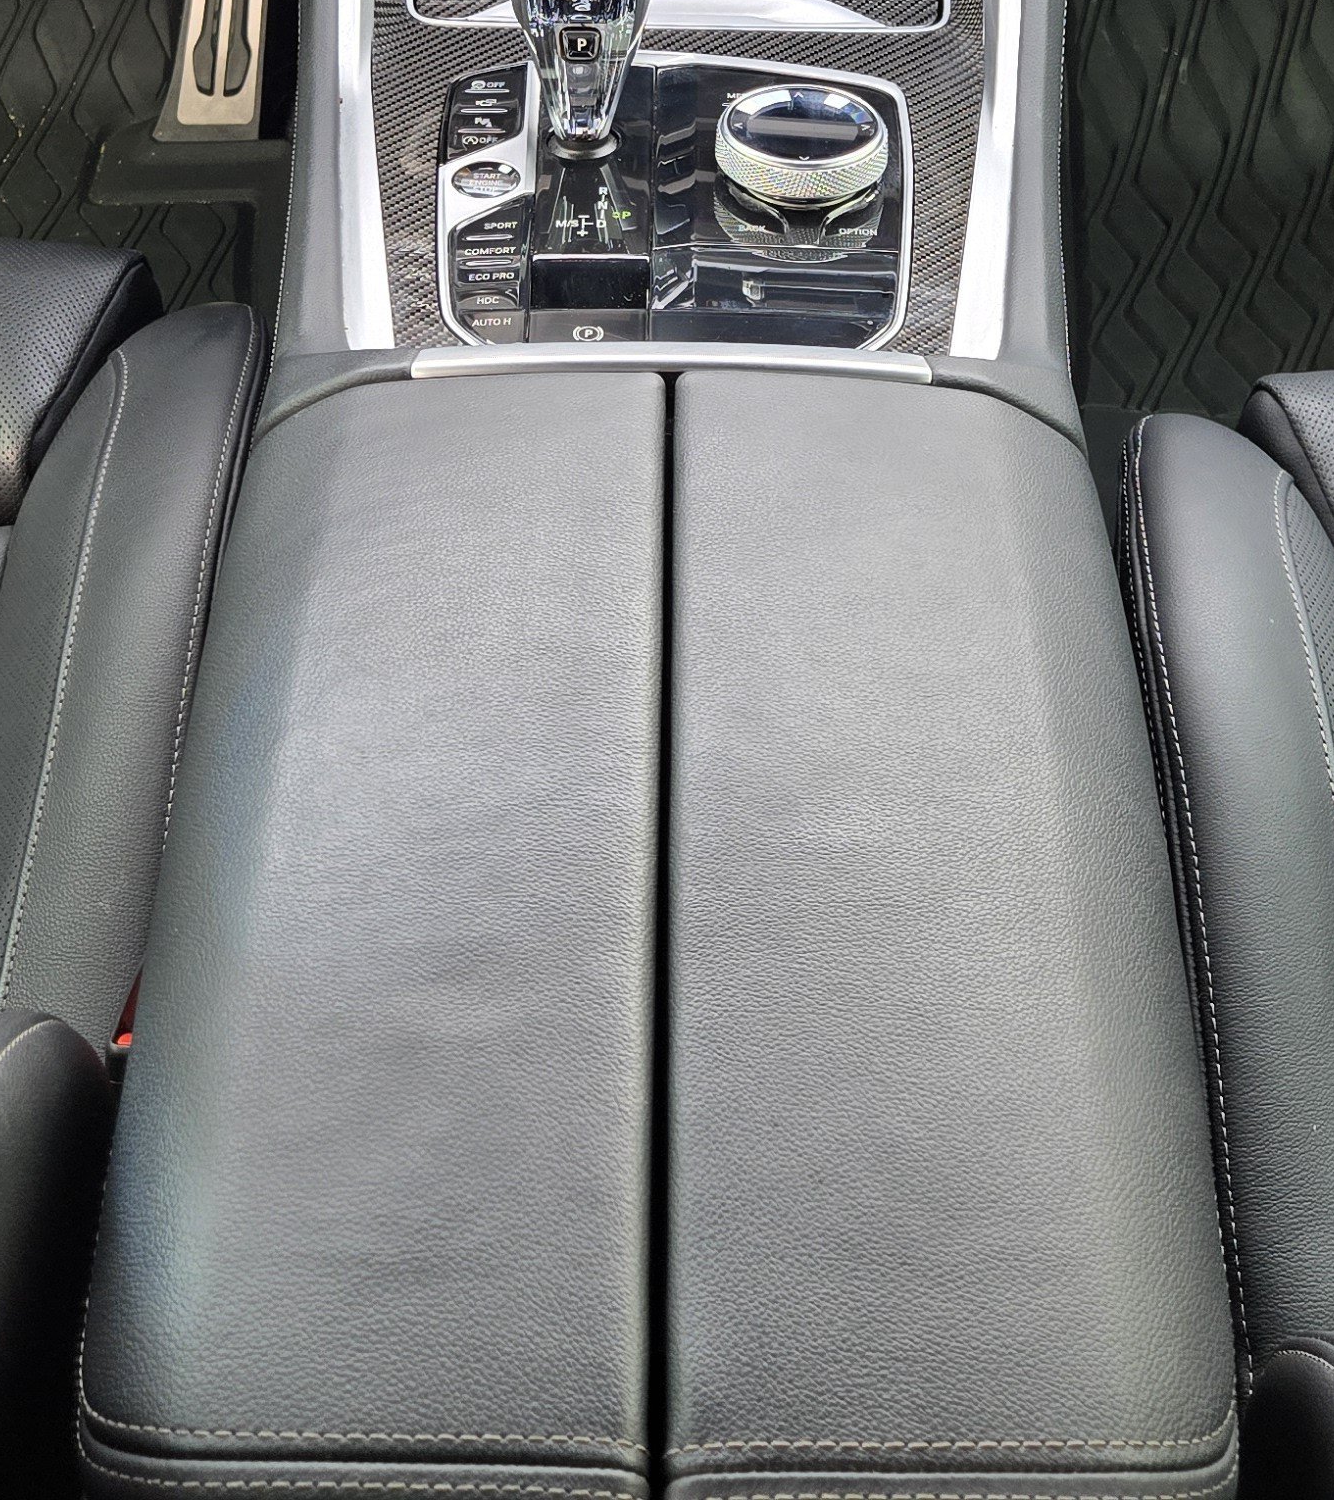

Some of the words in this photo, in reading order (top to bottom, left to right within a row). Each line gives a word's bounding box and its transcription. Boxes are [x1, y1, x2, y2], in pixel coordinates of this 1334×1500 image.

[577, 37, 588, 52] P
[473, 172, 501, 180] START
[598, 186, 608, 195] R
[598, 201, 608, 210] N
[484, 221, 518, 230] SPORT
[596, 220, 607, 229] D
[838, 228, 878, 236] OPTION
[465, 246, 517, 256] COMFORT
[469, 273, 490, 281] ECO
[492, 272, 515, 280] PRO
[477, 296, 499, 305] HDC
[471, 318, 501, 327] AUTO
[503, 317, 511, 326] H
